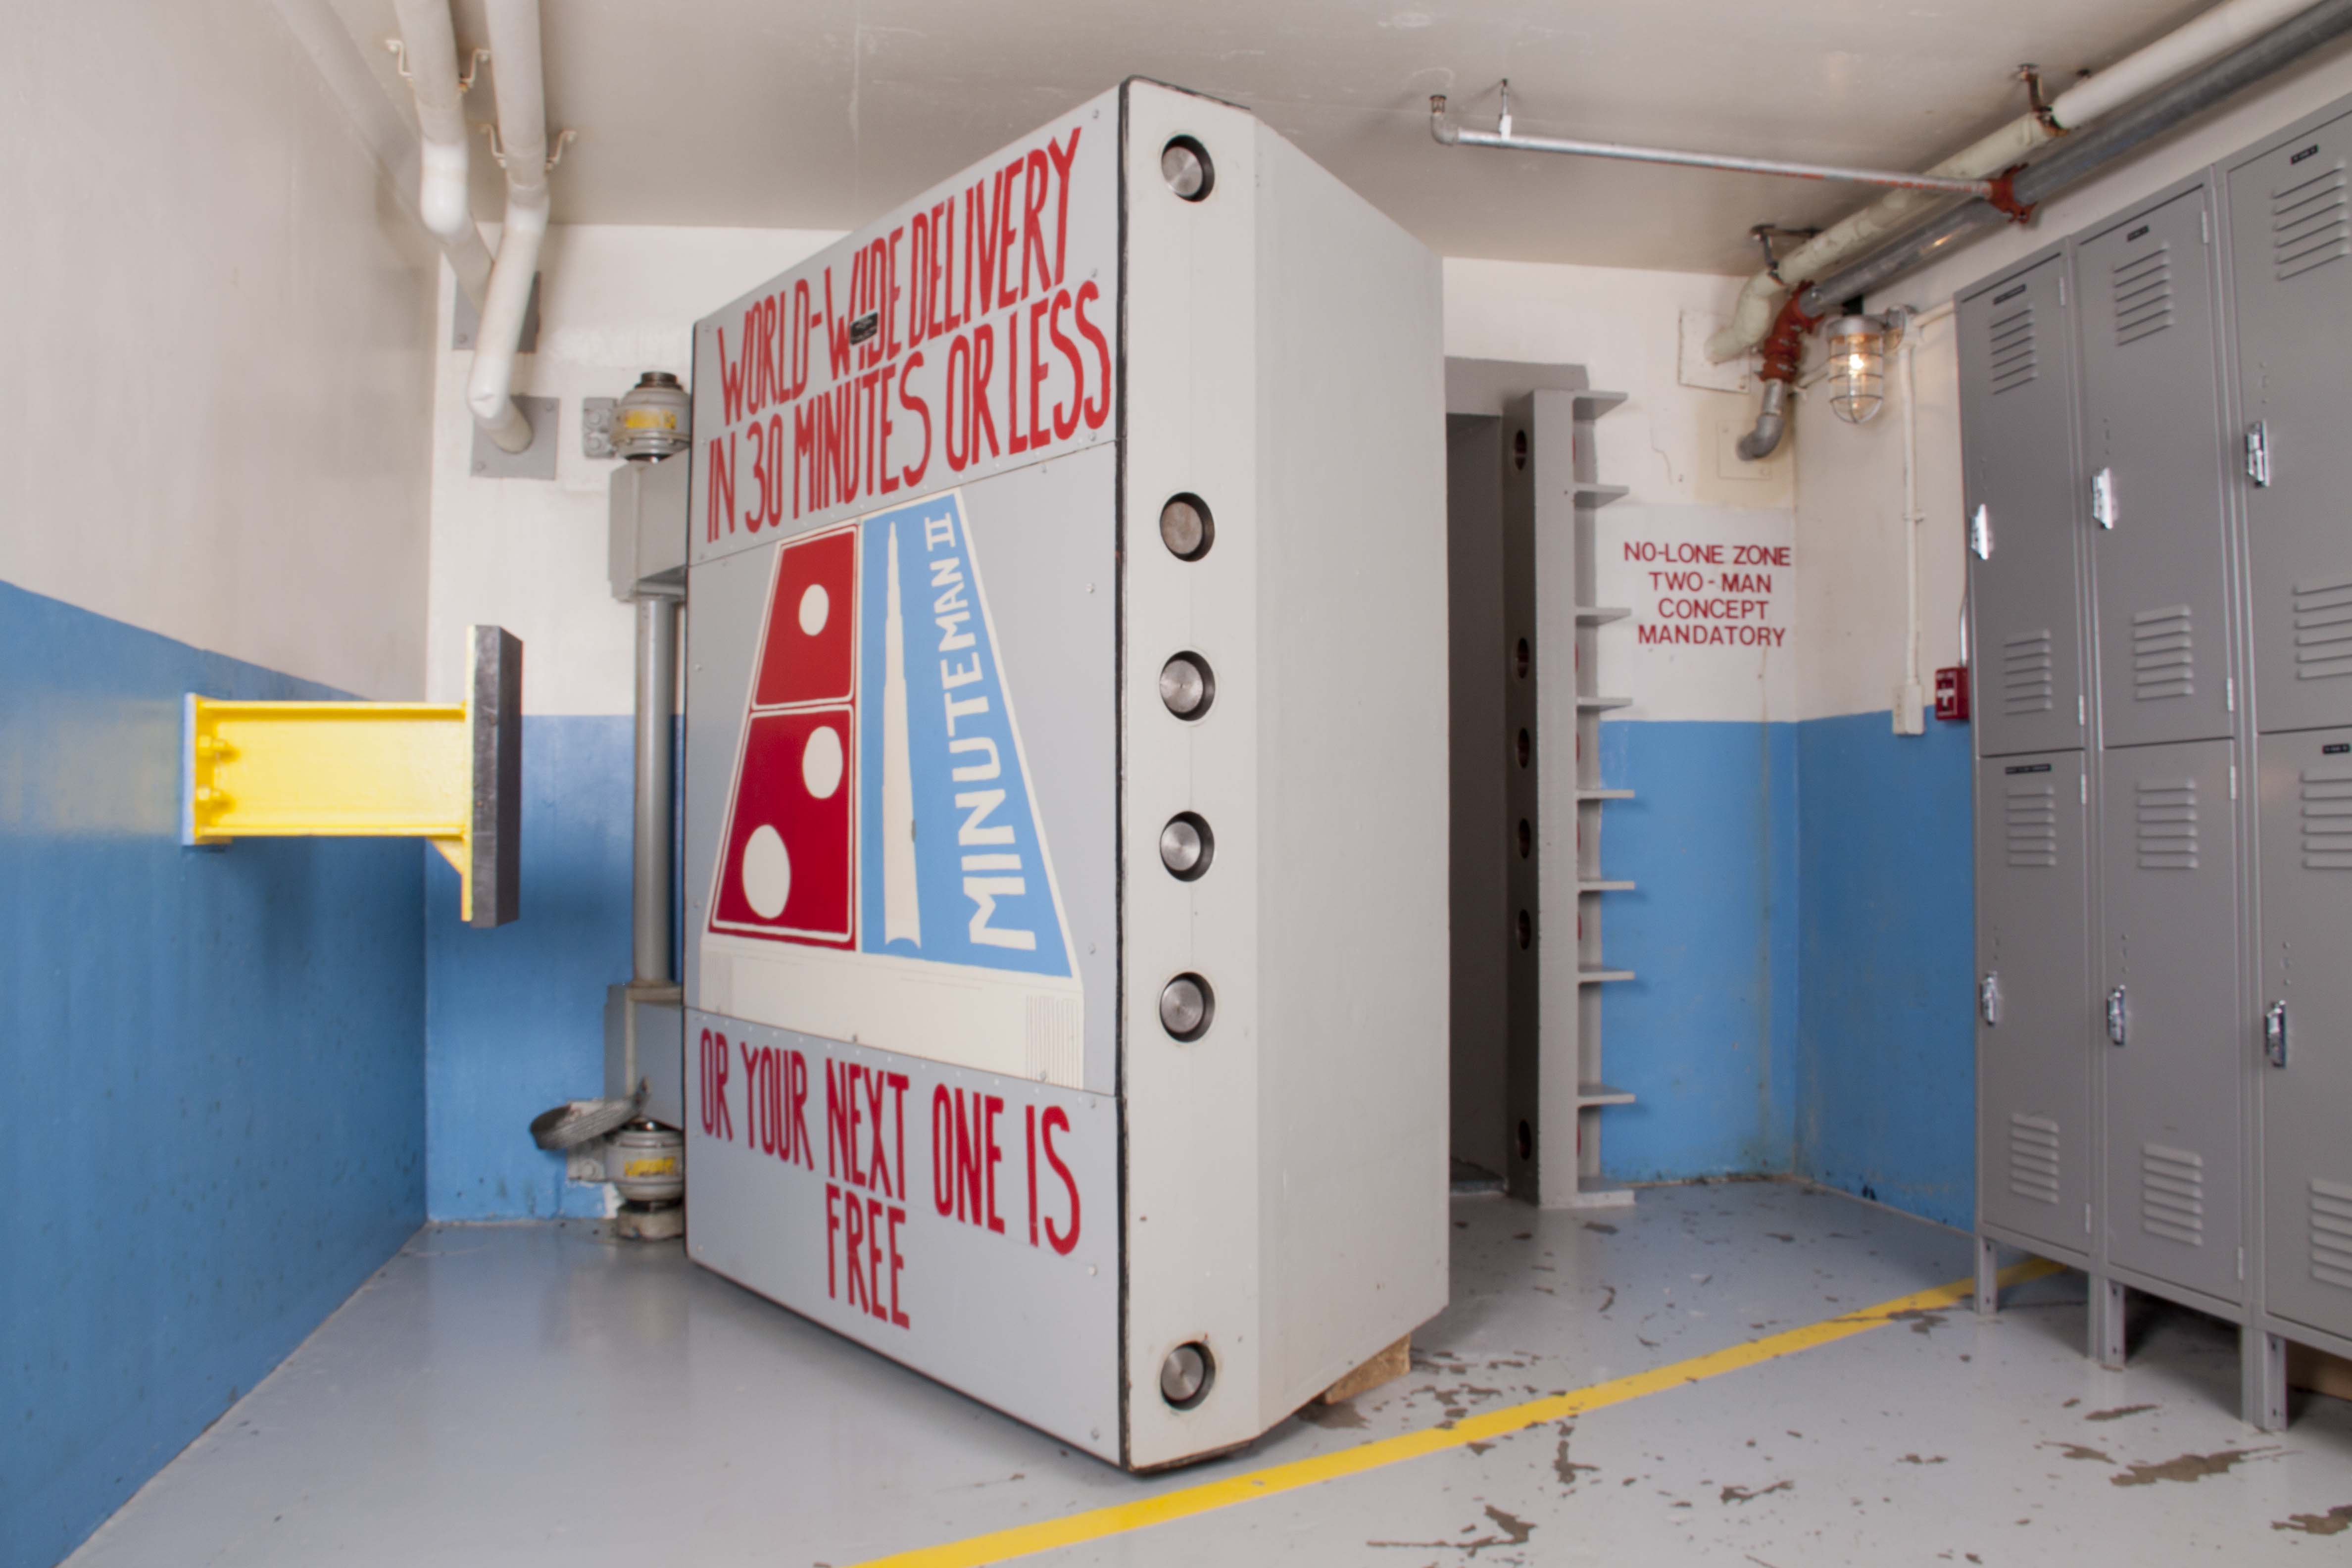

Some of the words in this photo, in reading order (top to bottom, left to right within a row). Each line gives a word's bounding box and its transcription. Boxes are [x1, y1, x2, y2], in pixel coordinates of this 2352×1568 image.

[718, 226, 903, 426] WORLD-WIDE
[909, 127, 1081, 349] DELIVERY
[707, 428, 736, 543] IN
[745, 414, 783, 533] 30
[794, 351, 932, 519] MINUTES
[946, 323, 1000, 472] OR
[1009, 280, 1111, 456] LESS
[925, 512, 956, 551] II
[1624, 542, 1723, 564] NO-LONE
[1733, 545, 1791, 566] ZONE
[1638, 625, 1785, 646] MANDATORY
[1659, 598, 1769, 619] CONCEPT
[930, 557, 1036, 951] MINUTEMAN
[700, 1028, 733, 1142] OR
[740, 1041, 813, 1170] YOUR
[826, 1058, 910, 1201] NEXT
[932, 1083, 1005, 1234] ONE
[1026, 1105, 1080, 1256] IS
[826, 1182, 910, 1330] FREE
